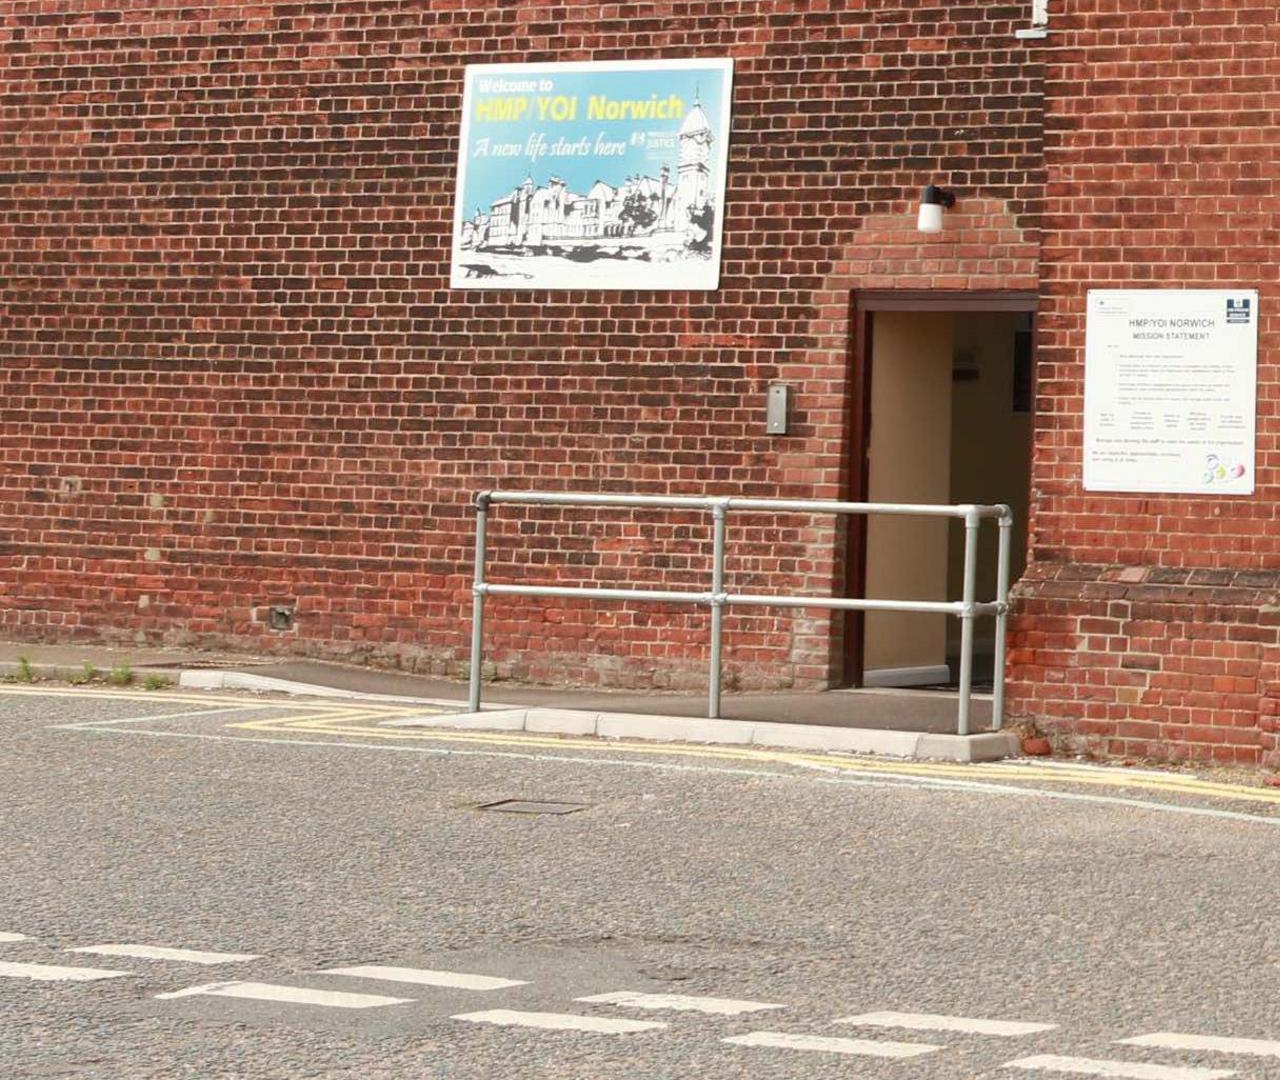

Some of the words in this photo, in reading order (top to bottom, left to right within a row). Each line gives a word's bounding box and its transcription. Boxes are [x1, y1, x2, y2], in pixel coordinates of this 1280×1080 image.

[478, 78, 537, 93] Welcome
[540, 79, 554, 92] to
[587, 94, 683, 120] Norwich
[473, 136, 489, 158] A
[493, 143, 522, 157] new
[525, 132, 548, 163] life
[549, 135, 591, 156] starts
[593, 131, 627, 156] here
[1170, 319, 1215, 328] NORWICH
[1133, 332, 1164, 340] MISSION
[1166, 332, 1210, 340] STATEMENT
